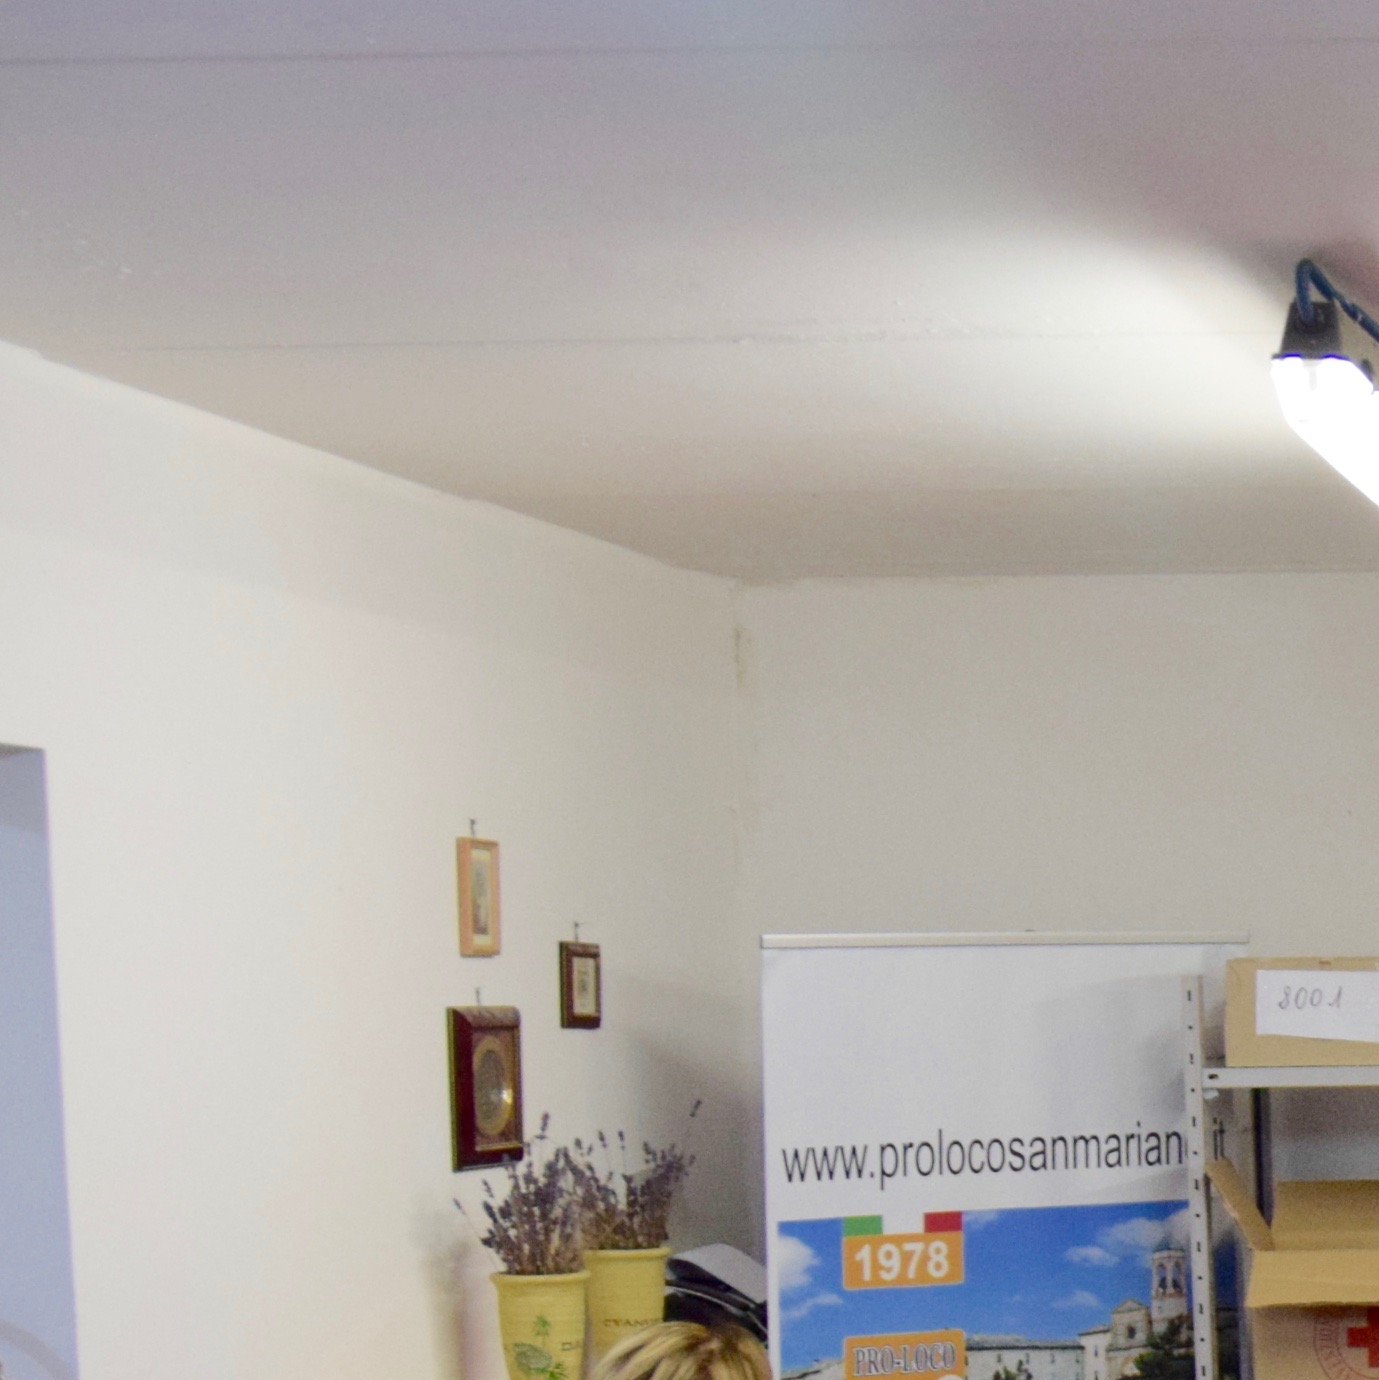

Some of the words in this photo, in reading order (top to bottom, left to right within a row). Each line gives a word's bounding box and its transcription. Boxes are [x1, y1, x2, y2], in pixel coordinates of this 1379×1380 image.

[782, 1117, 1225, 1190] www.prolocosanmarianit
[855, 1241, 949, 1281] 1978
[854, 1342, 955, 1376] PRO-LOCO
